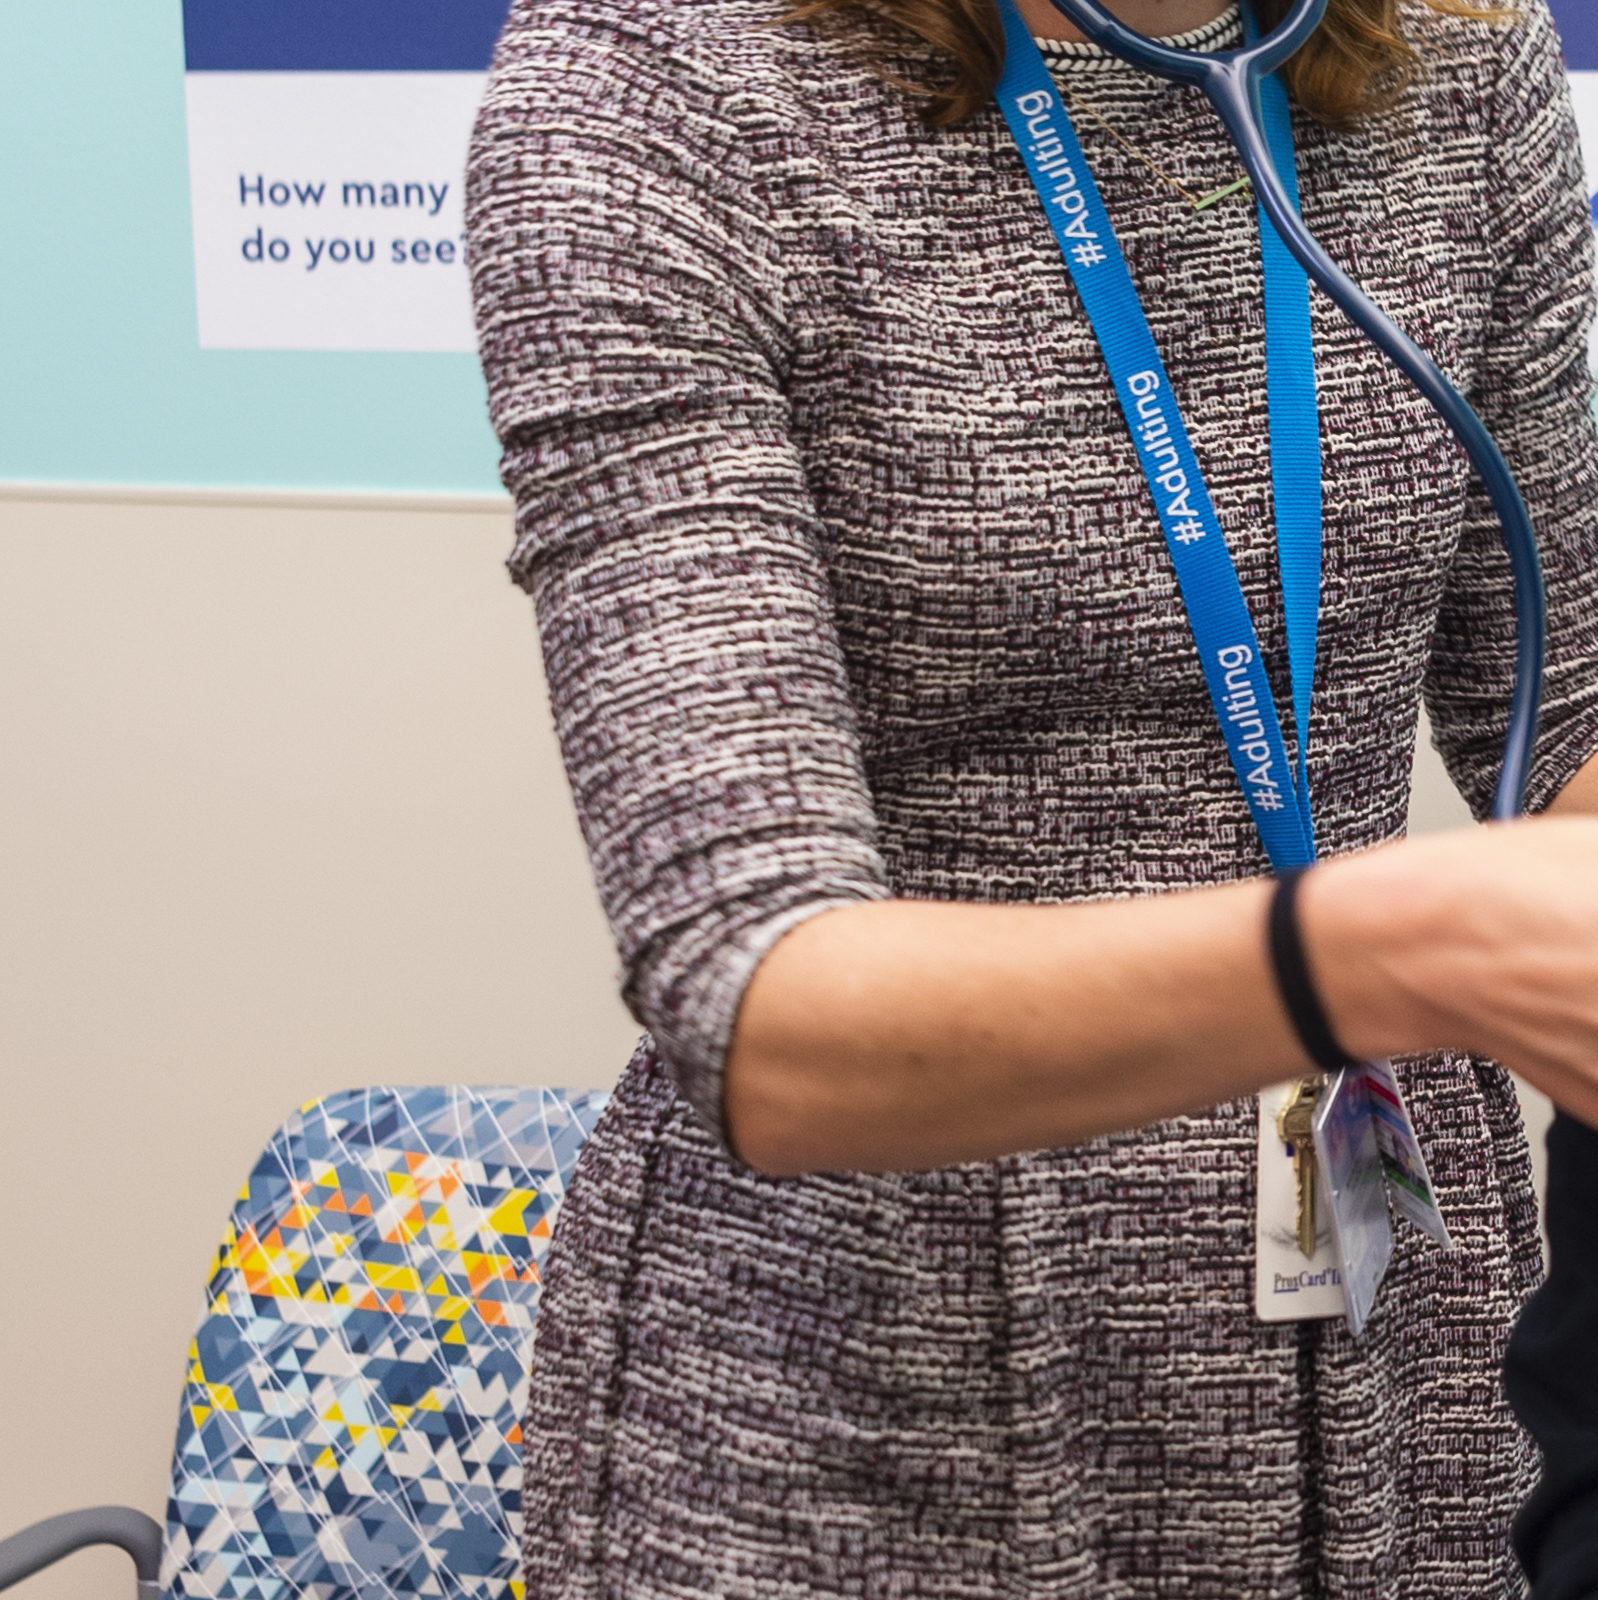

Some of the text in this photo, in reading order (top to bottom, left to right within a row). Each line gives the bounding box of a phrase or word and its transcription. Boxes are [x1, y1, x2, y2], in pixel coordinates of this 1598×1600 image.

[239, 174, 449, 216] How many
[241, 227, 290, 263] do
[305, 237, 375, 272] you
[1015, 89, 1107, 268] #Adulting
[1127, 370, 1206, 545] #Adulting
[1217, 644, 1285, 811] #Adulting
